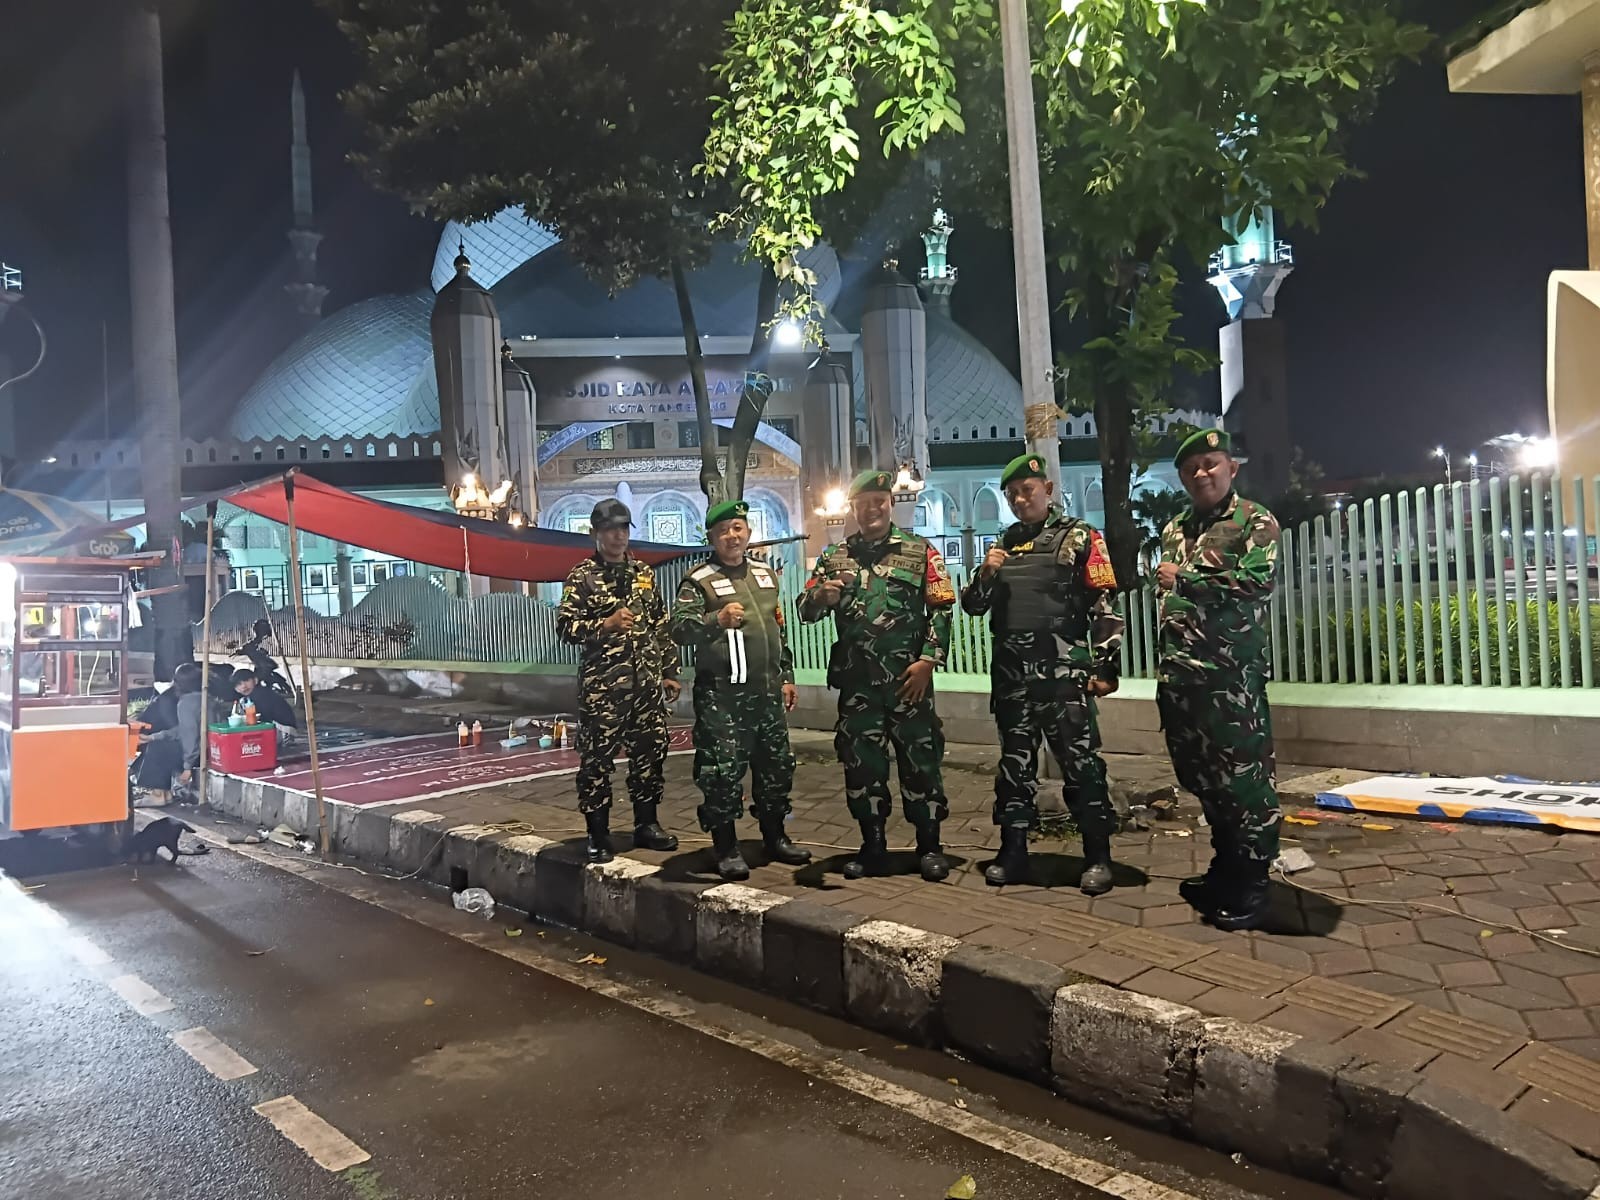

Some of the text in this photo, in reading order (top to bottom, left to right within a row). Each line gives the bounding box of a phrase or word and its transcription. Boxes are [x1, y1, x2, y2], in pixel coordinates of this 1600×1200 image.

[555, 382, 610, 398] SJID
[616, 381, 671, 397] RAYA
[608, 402, 728, 415] KOTA TANGENG
[89, 540, 119, 557] Grab
[892, 559, 921, 572] TNI-AD
